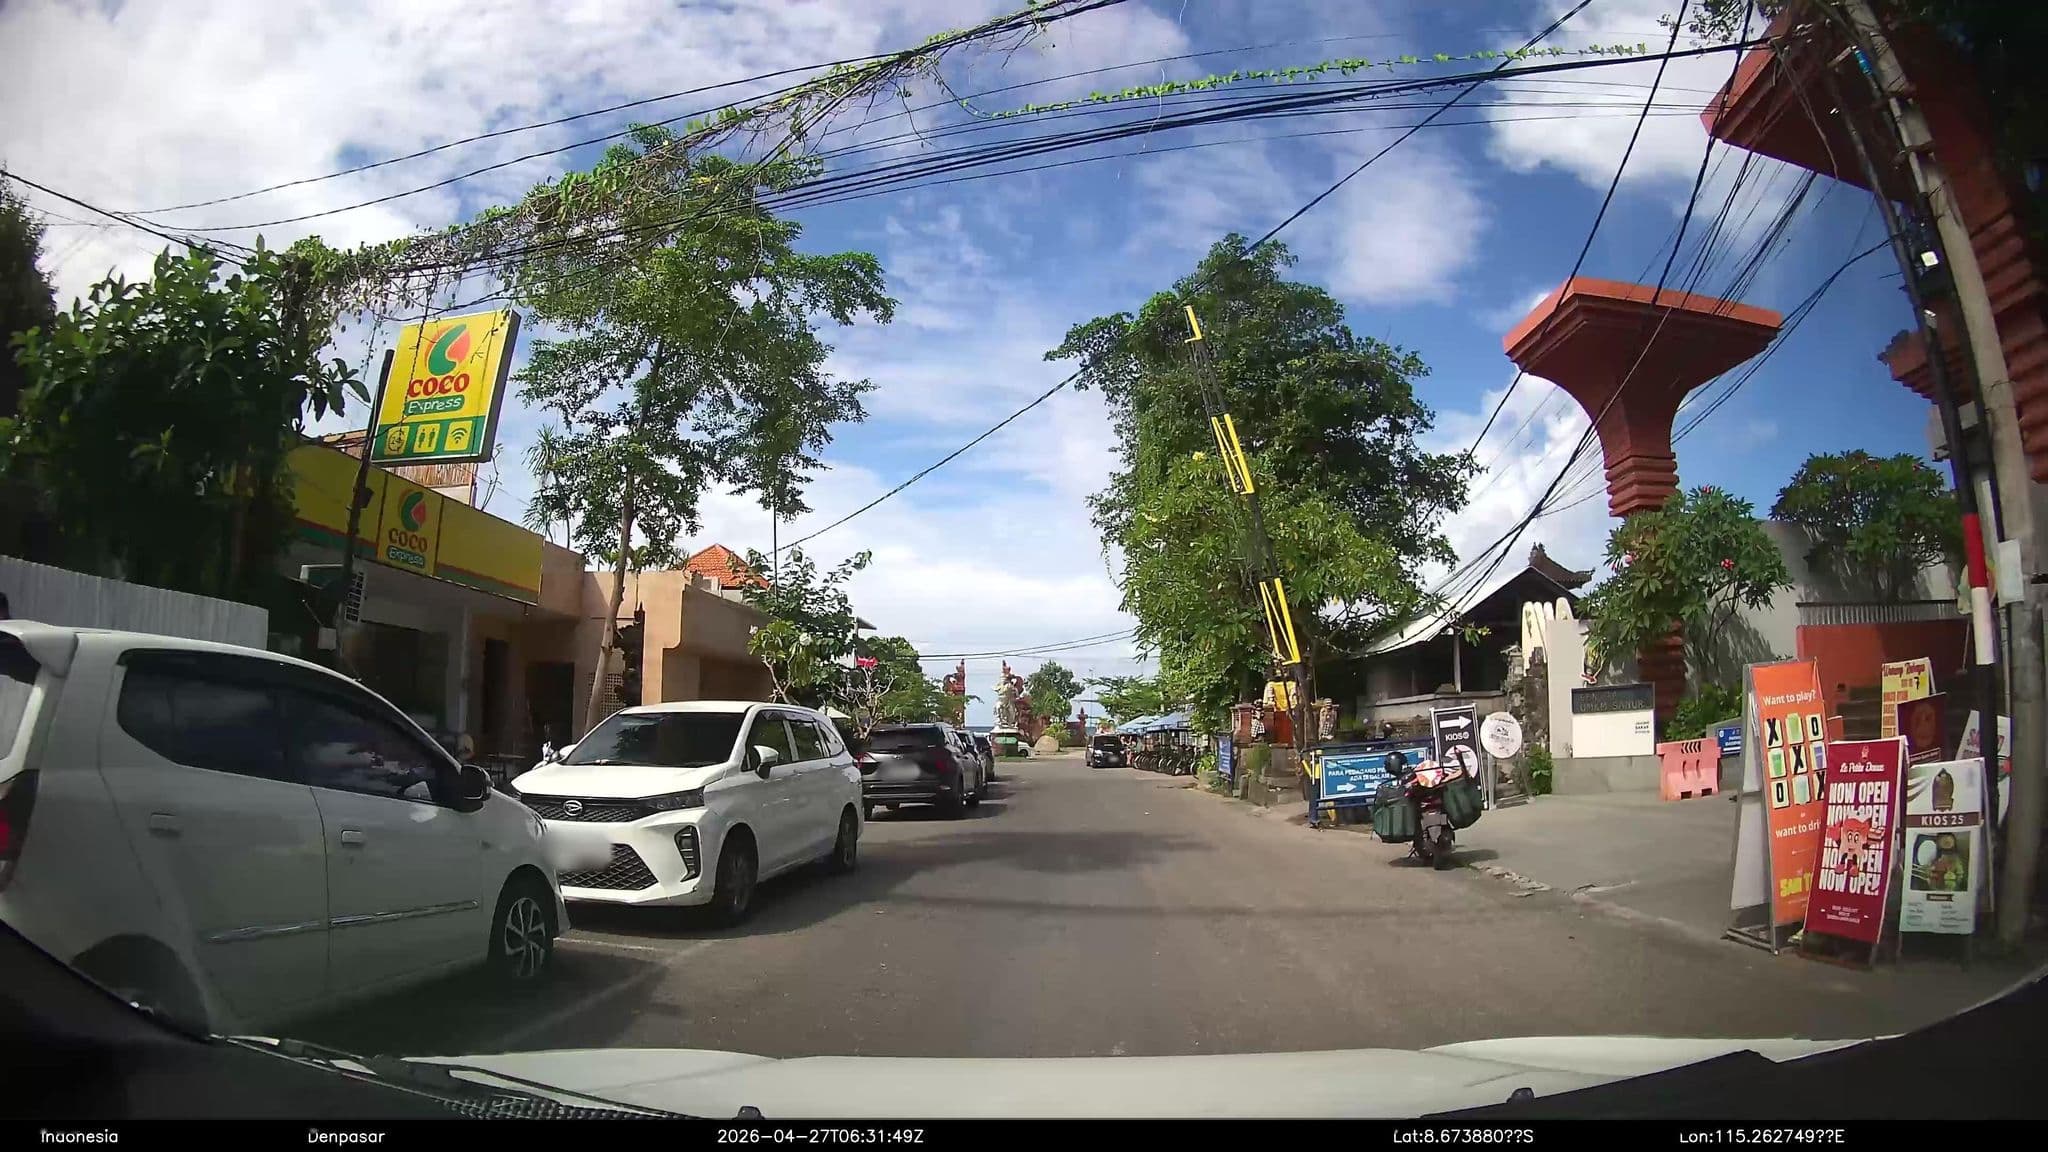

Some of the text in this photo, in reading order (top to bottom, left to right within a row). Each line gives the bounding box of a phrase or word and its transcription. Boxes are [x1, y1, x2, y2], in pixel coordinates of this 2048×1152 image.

[408, 373, 470, 398] COCO
[408, 396, 462, 414] Express
[388, 527, 428, 553] COCO
[1763, 690, 1816, 706] Want to play?
[1828, 780, 1890, 804] NOW OPEN
[1775, 818, 1821, 838] want to dri
[1921, 814, 1964, 826] KIOS 25
[1857, 848, 1884, 875] PEN
[1818, 868, 1848, 893] NOW
